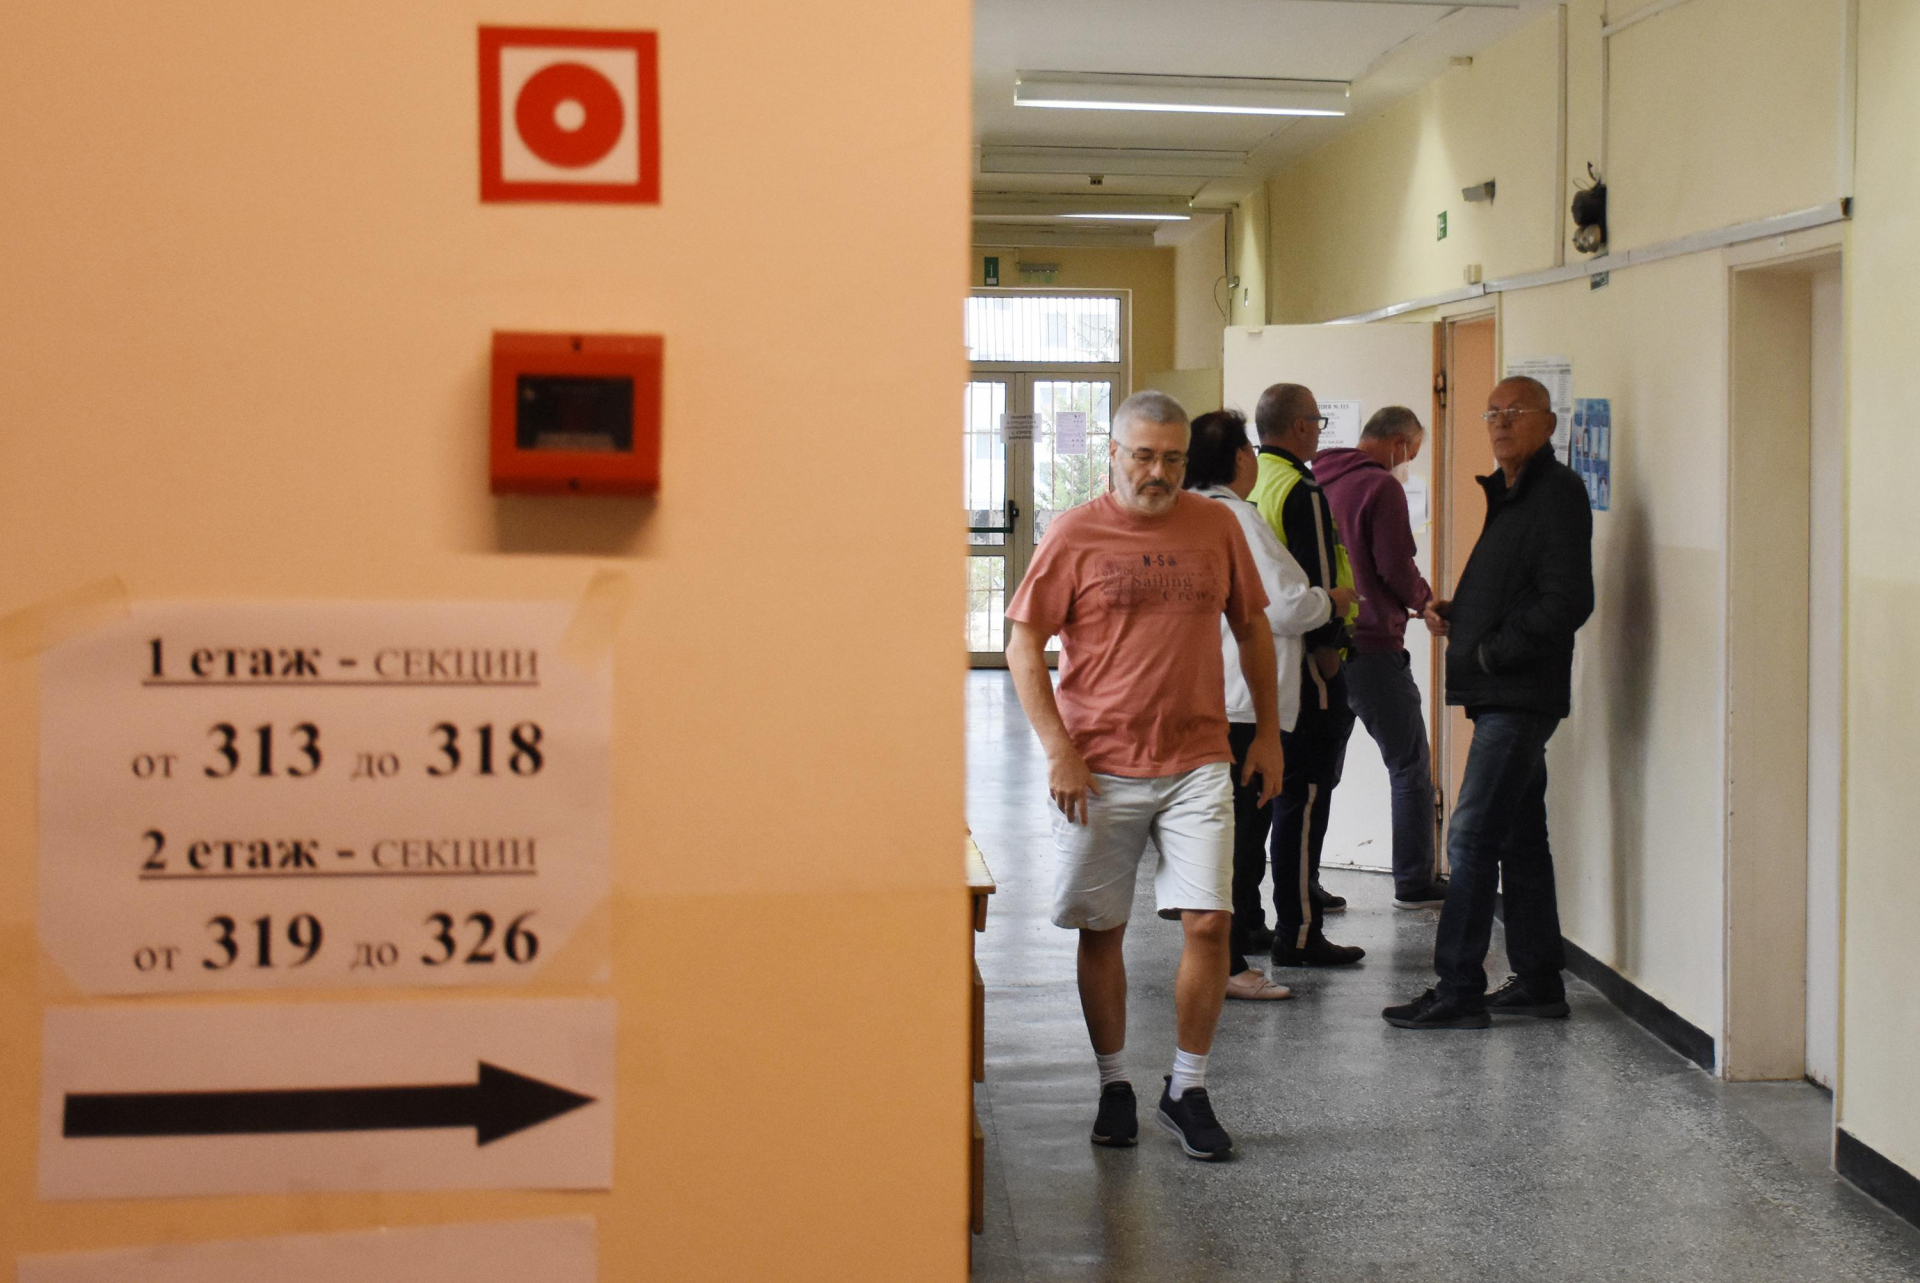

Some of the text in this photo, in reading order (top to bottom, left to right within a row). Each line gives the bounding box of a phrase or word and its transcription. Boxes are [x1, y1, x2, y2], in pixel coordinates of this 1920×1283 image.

[1133, 573, 1193, 590] Sailing
[149, 637, 164, 678] 1
[190, 647, 321, 678] етаж
[373, 647, 539, 683] СЕКЦИИ
[131, 720, 546, 782] от 313 до 318
[141, 829, 167, 871] 2
[187, 838, 320, 870] етаж
[371, 837, 538, 874] СЕКЦИИ
[133, 909, 541, 972] от 319 до 326
